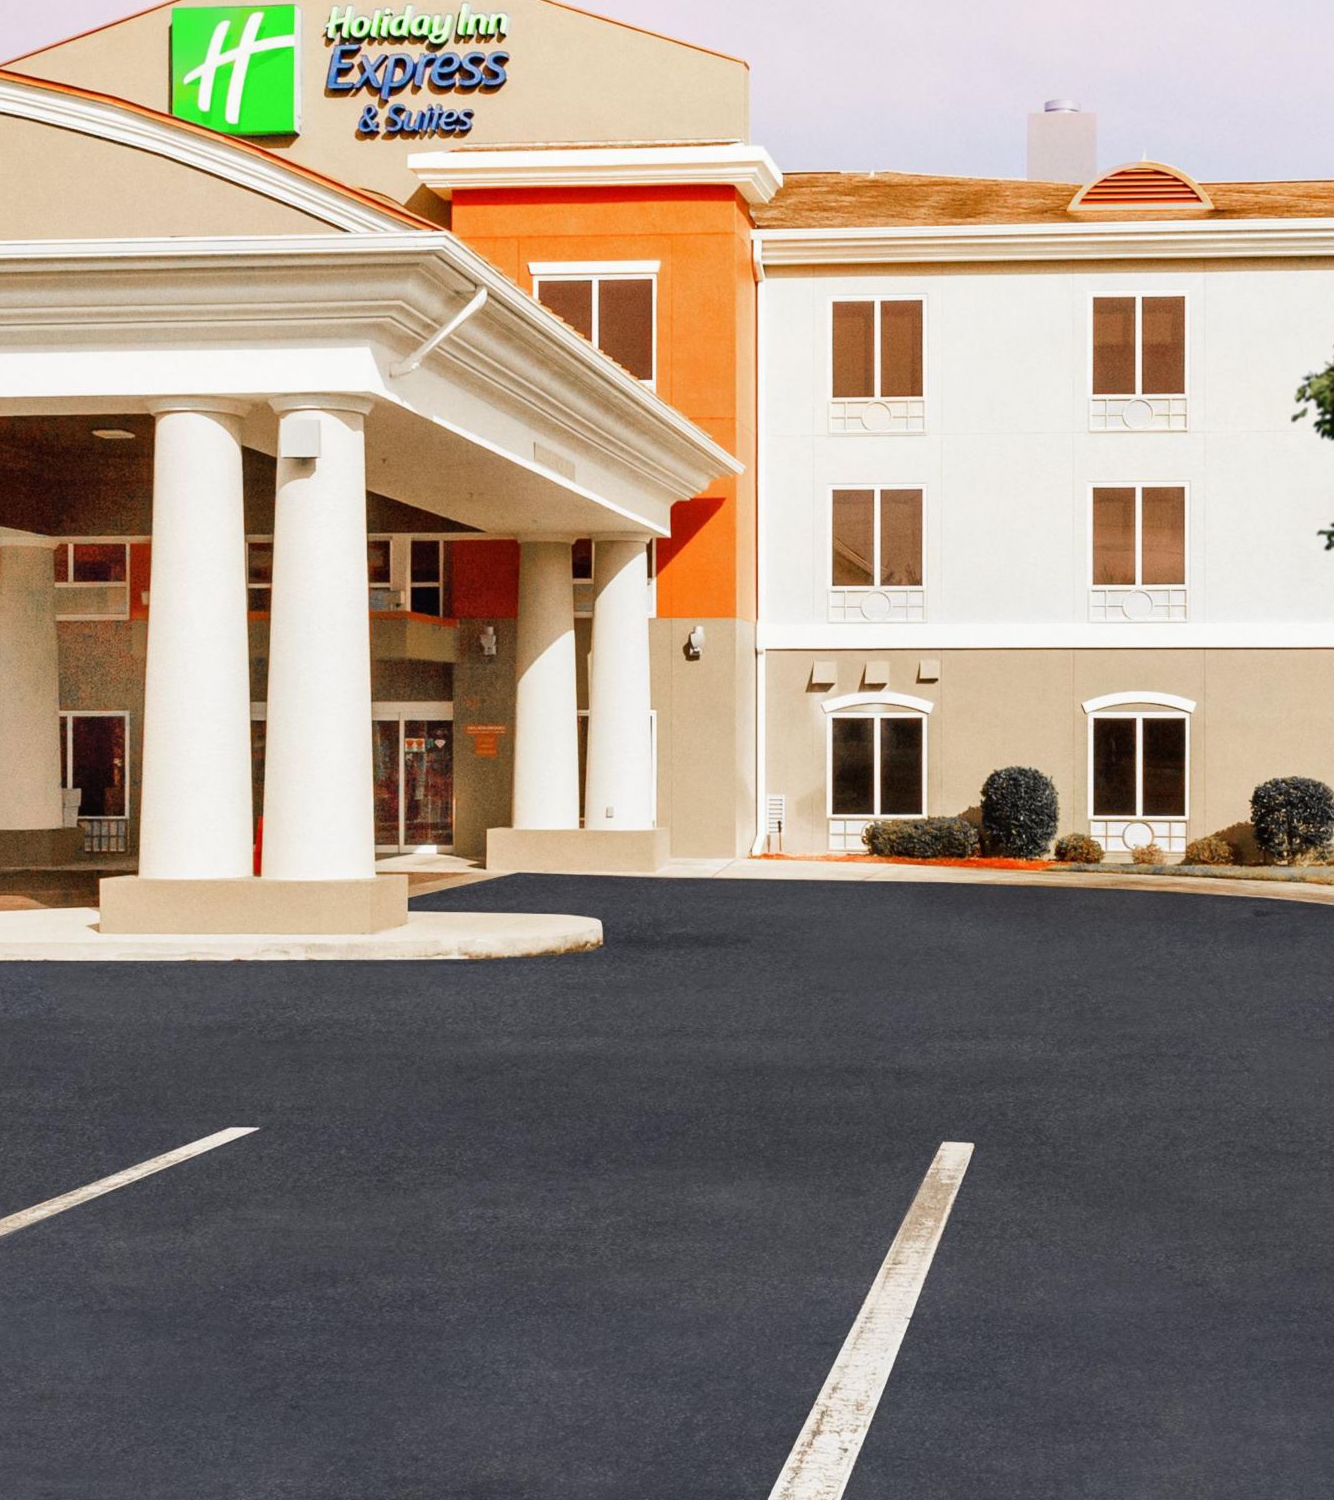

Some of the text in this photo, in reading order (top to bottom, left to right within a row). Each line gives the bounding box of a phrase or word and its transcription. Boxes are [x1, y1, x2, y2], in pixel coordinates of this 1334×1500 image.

[325, 2, 510, 45] Holiday Inn
[327, 44, 511, 101] Express
[358, 103, 475, 134] & Suites
